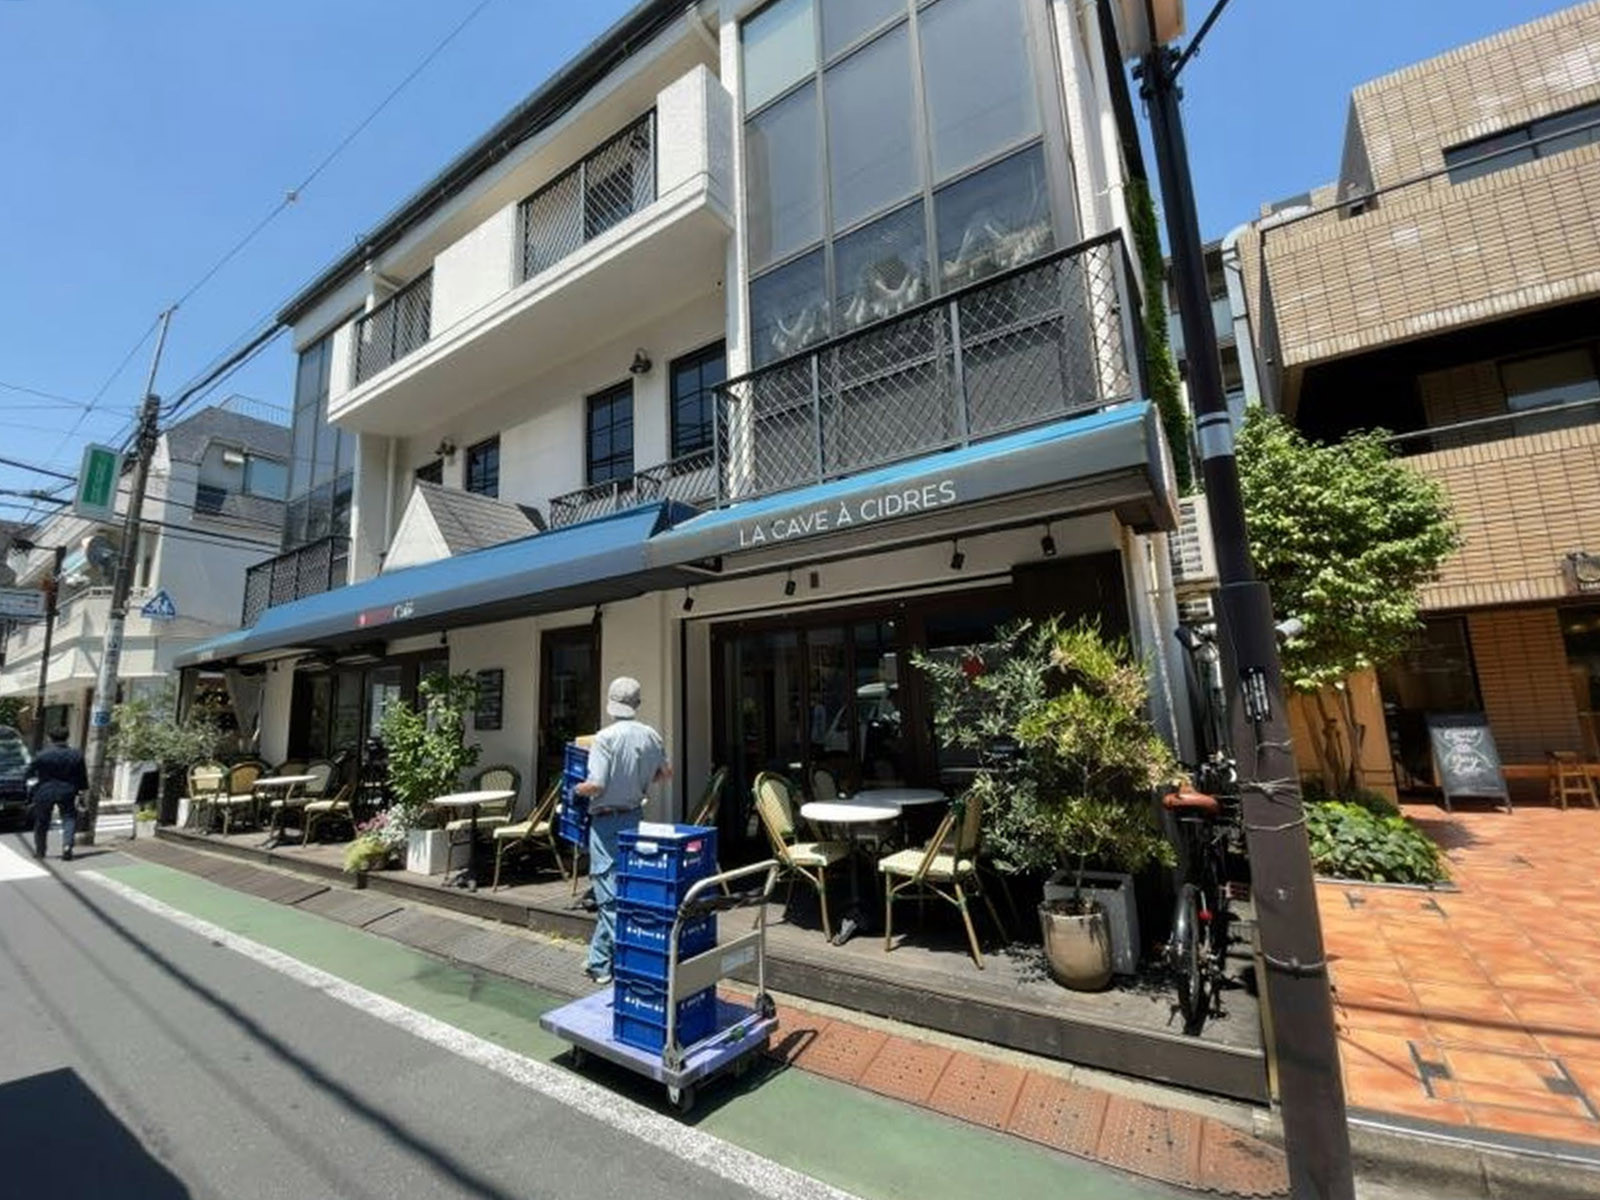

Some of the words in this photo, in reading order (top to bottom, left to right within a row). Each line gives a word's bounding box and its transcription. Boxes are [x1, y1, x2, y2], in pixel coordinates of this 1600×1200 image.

[740, 525, 766, 546] LA
[771, 510, 829, 539] CAVE
[836, 501, 852, 527] À
[860, 480, 956, 521] CIDRES
